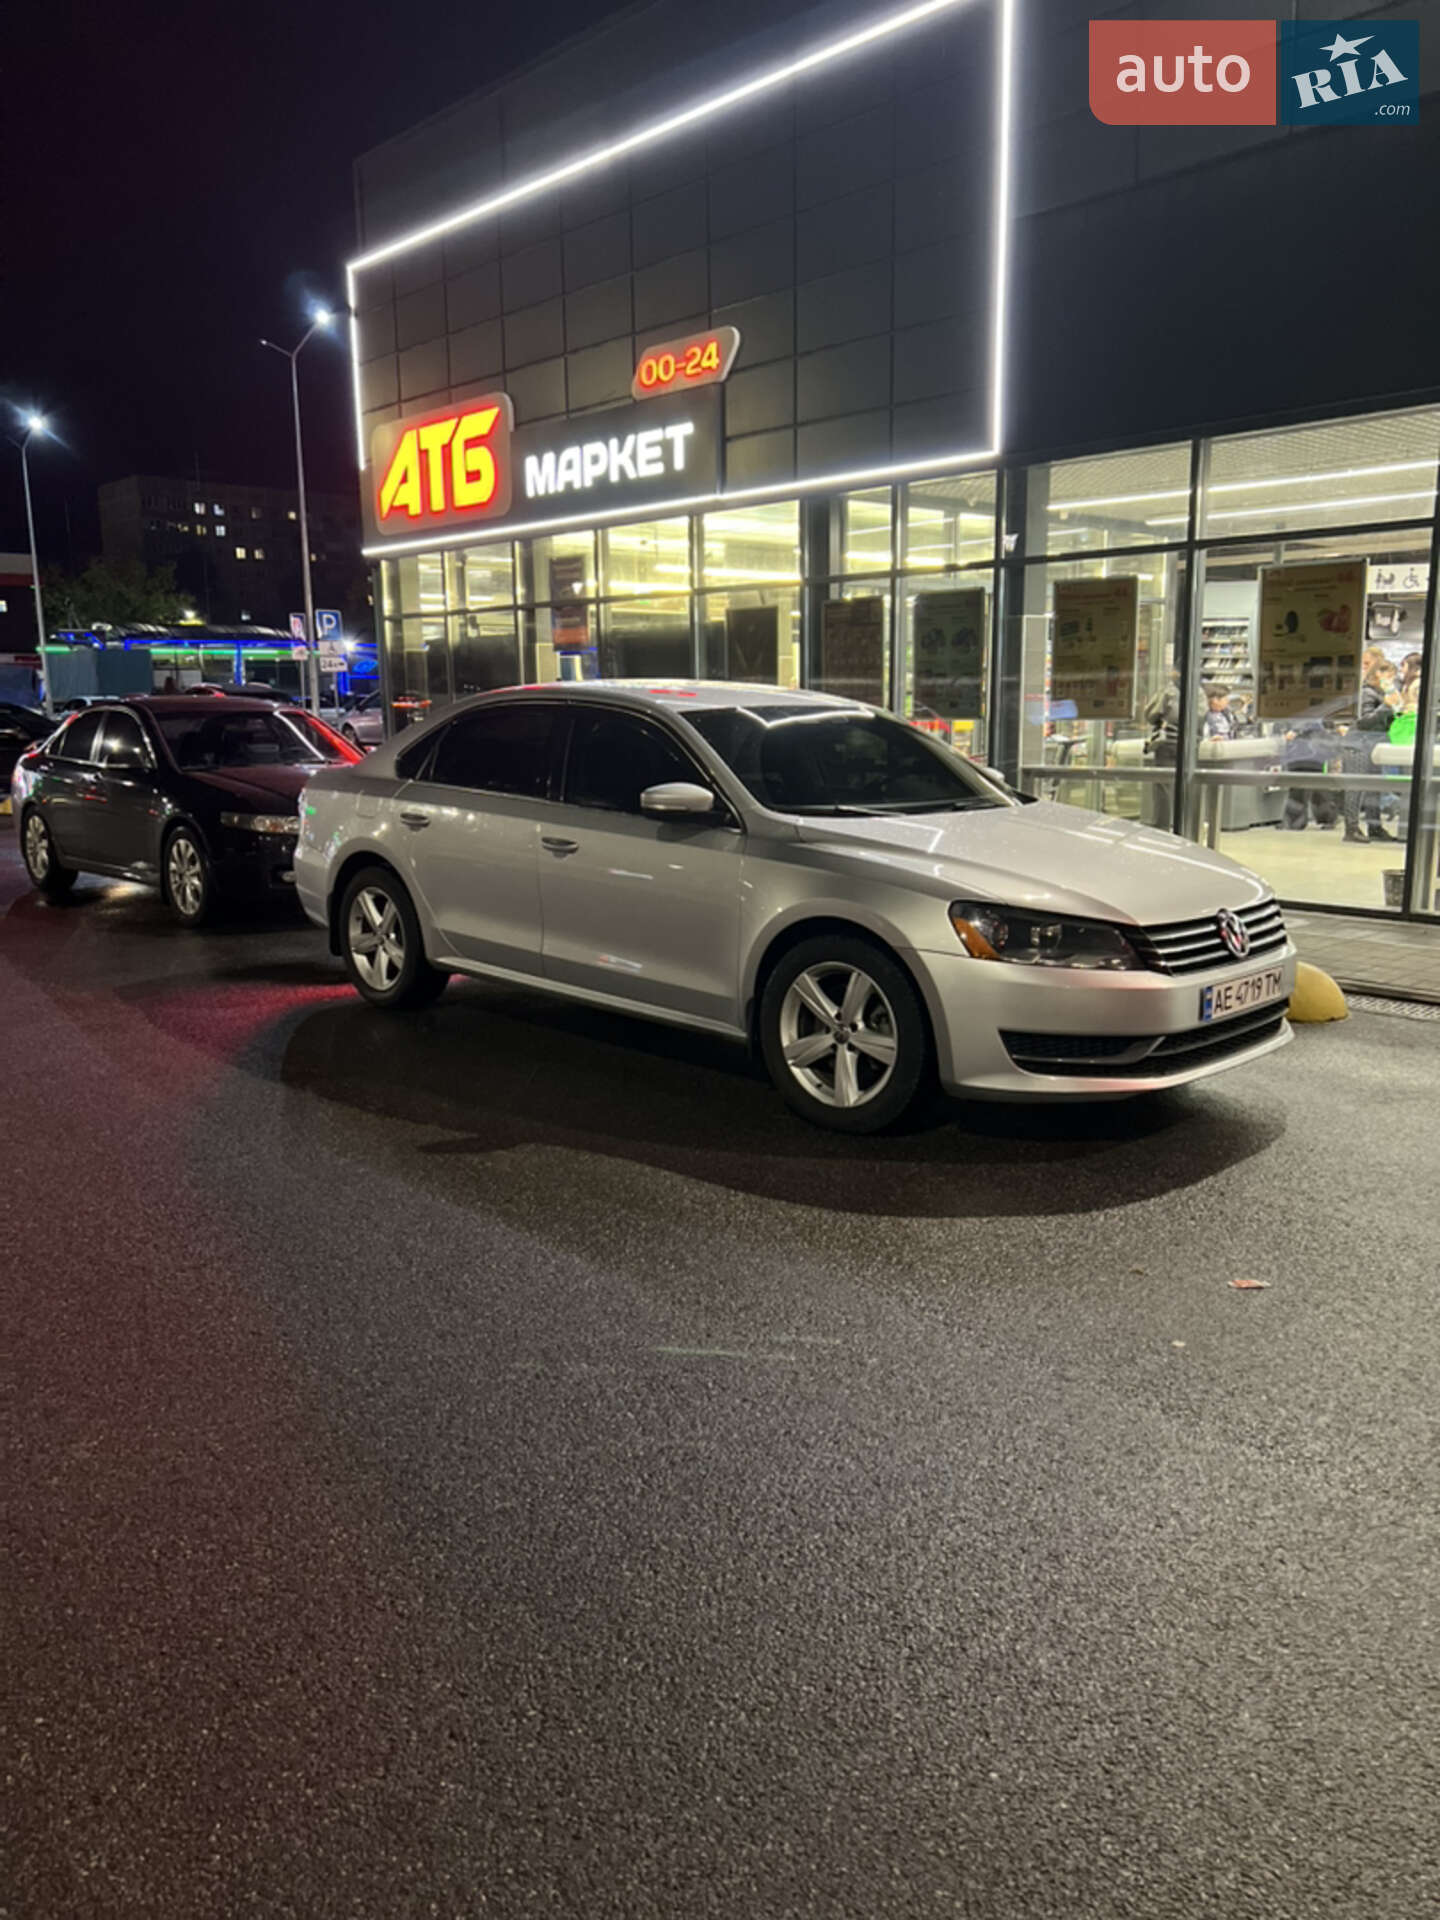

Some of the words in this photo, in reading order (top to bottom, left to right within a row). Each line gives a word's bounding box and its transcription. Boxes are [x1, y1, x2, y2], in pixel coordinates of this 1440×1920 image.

[641, 341, 719, 386] 00-24
[379, 406, 500, 519] АТБ
[525, 421, 694, 498] МАРКЕТ
[323, 614, 337, 636] P
[1214, 986, 1232, 1014] AE
[1265, 972, 1282, 997] TM
